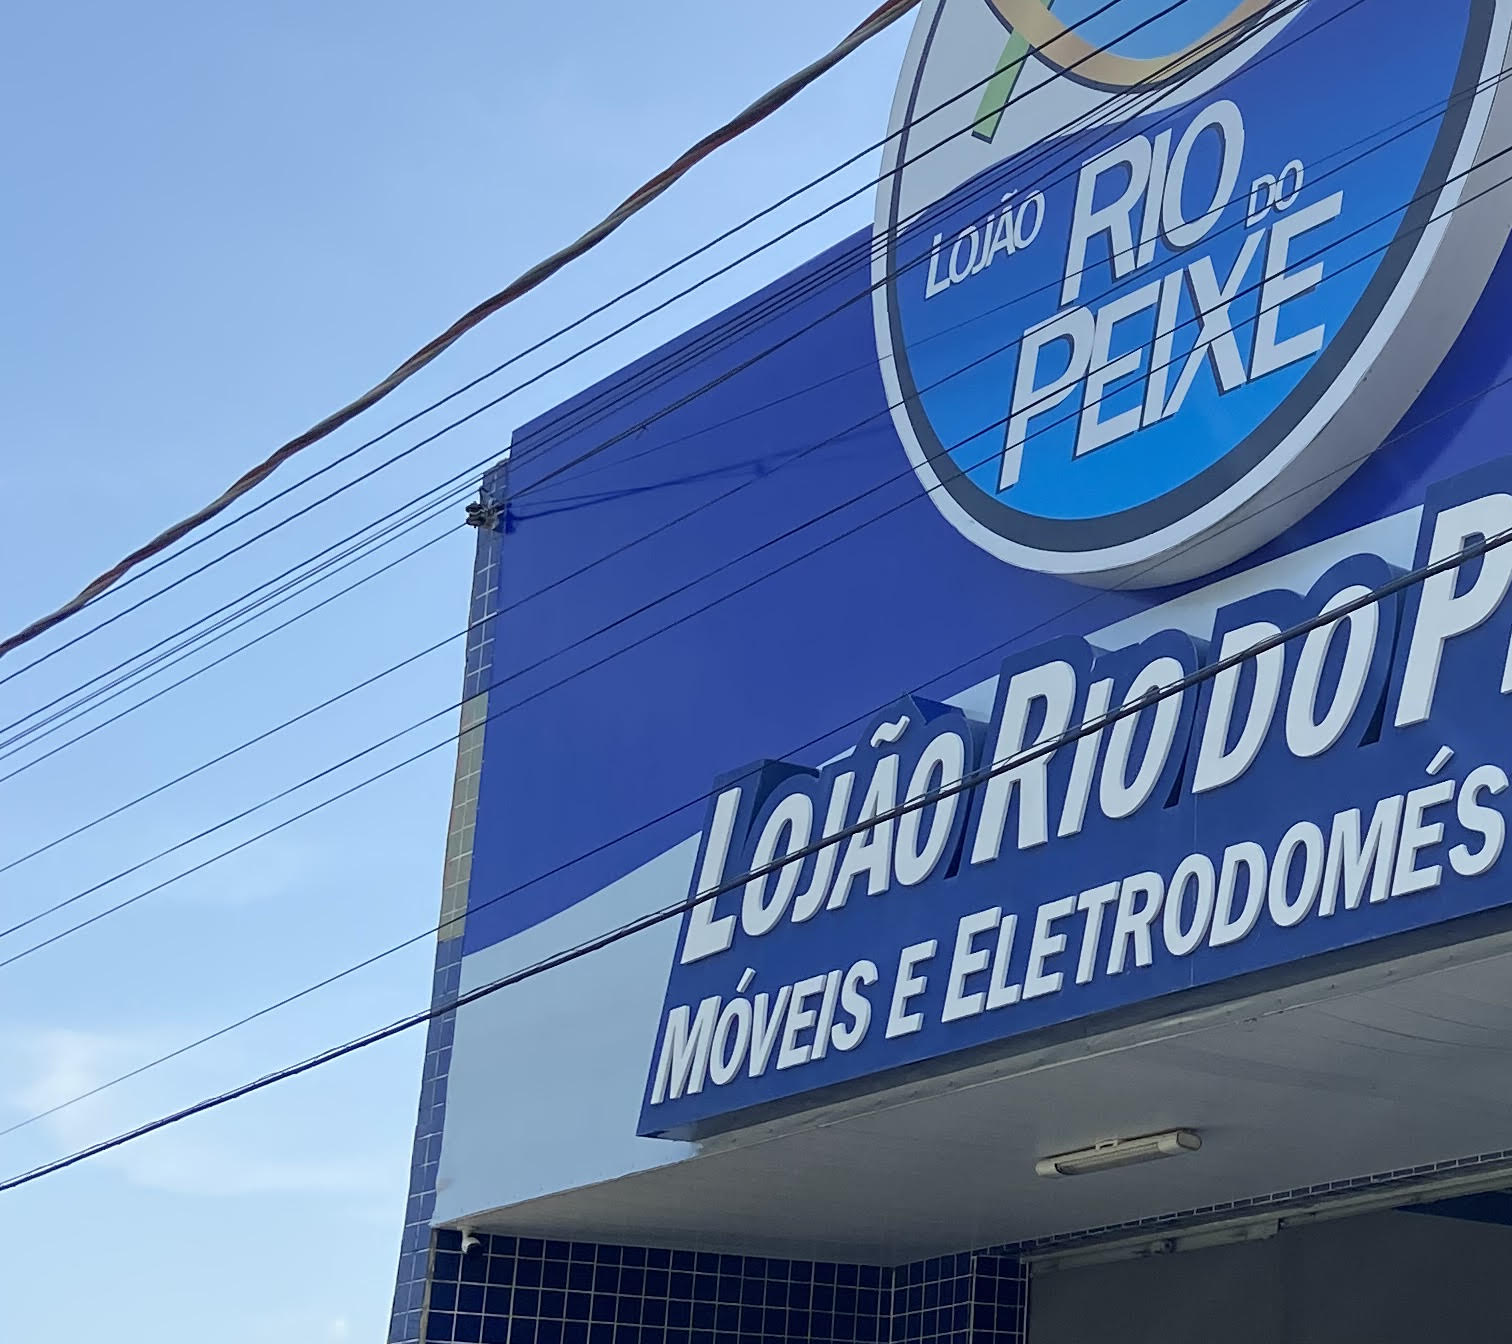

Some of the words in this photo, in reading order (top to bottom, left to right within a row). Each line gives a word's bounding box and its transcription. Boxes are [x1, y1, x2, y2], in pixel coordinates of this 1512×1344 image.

[924, 188, 1046, 299] LOJÃO
[1059, 98, 1246, 308] RIO
[1245, 158, 1305, 229] DO
[996, 190, 1344, 493] PEIXE
[680, 715, 966, 965] LOJÃO
[970, 659, 1185, 865] RIO
[1191, 585, 1379, 794] DO
[650, 967, 878, 1105] MÓVEIS
[886, 938, 937, 1039] E
